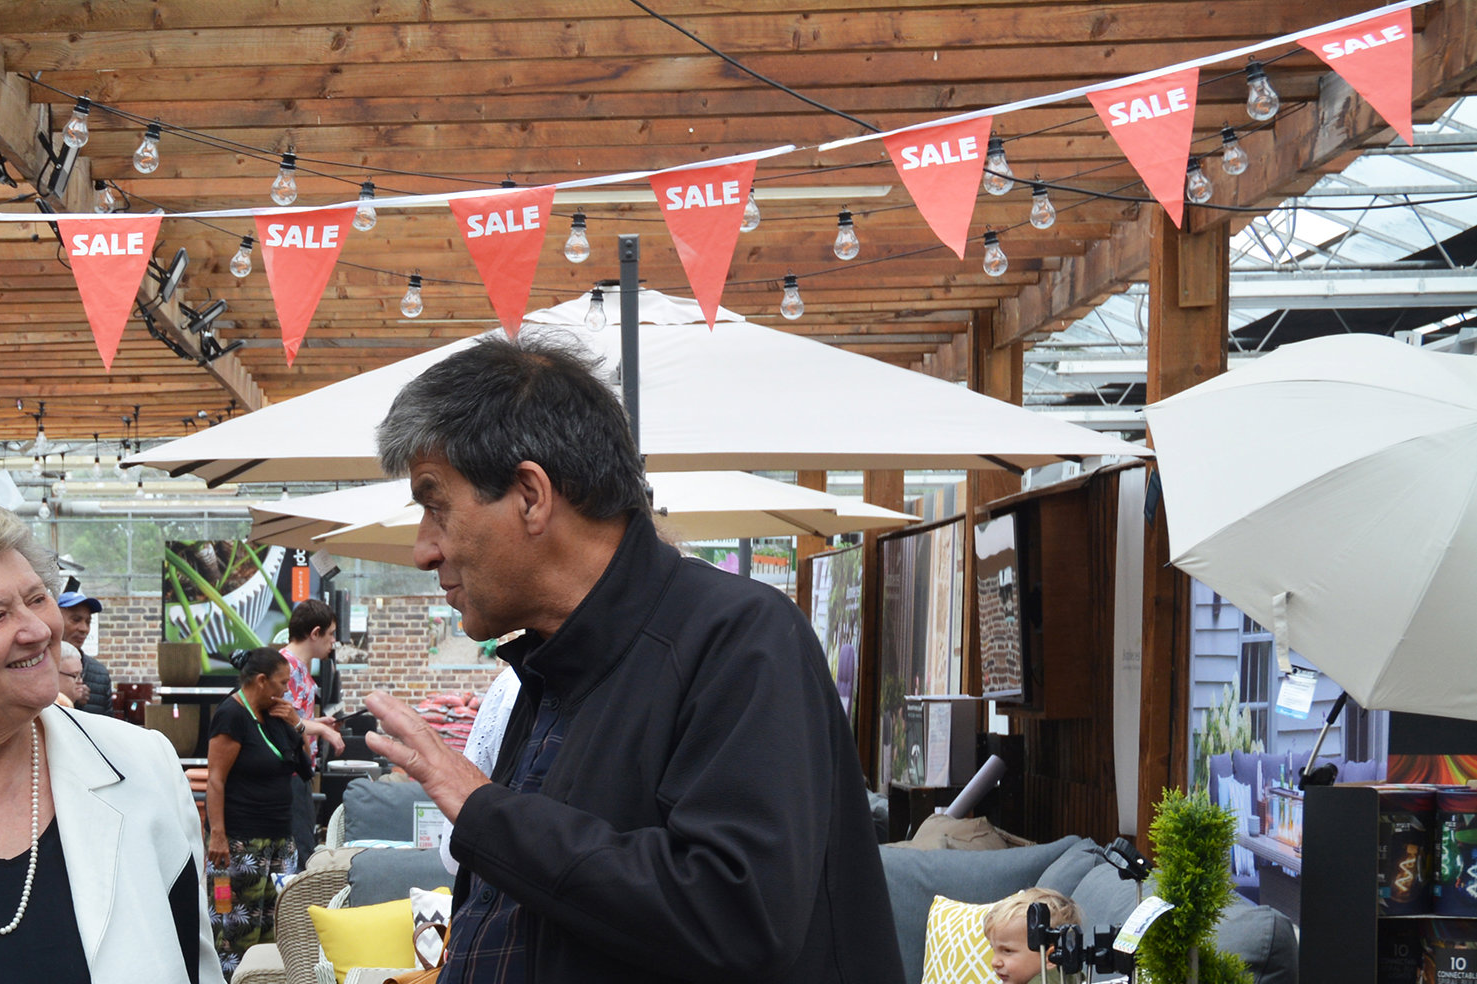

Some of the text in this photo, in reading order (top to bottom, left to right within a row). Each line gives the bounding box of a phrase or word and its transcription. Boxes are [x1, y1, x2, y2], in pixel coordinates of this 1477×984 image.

[1322, 25, 1405, 60] SALE
[1108, 88, 1189, 126] SALE
[901, 136, 979, 170] SALE
[666, 181, 740, 210] SALE
[266, 224, 339, 249] SALE
[467, 206, 541, 239] SALE
[71, 232, 144, 256] SALE
[1450, 956, 1467, 970] 10
